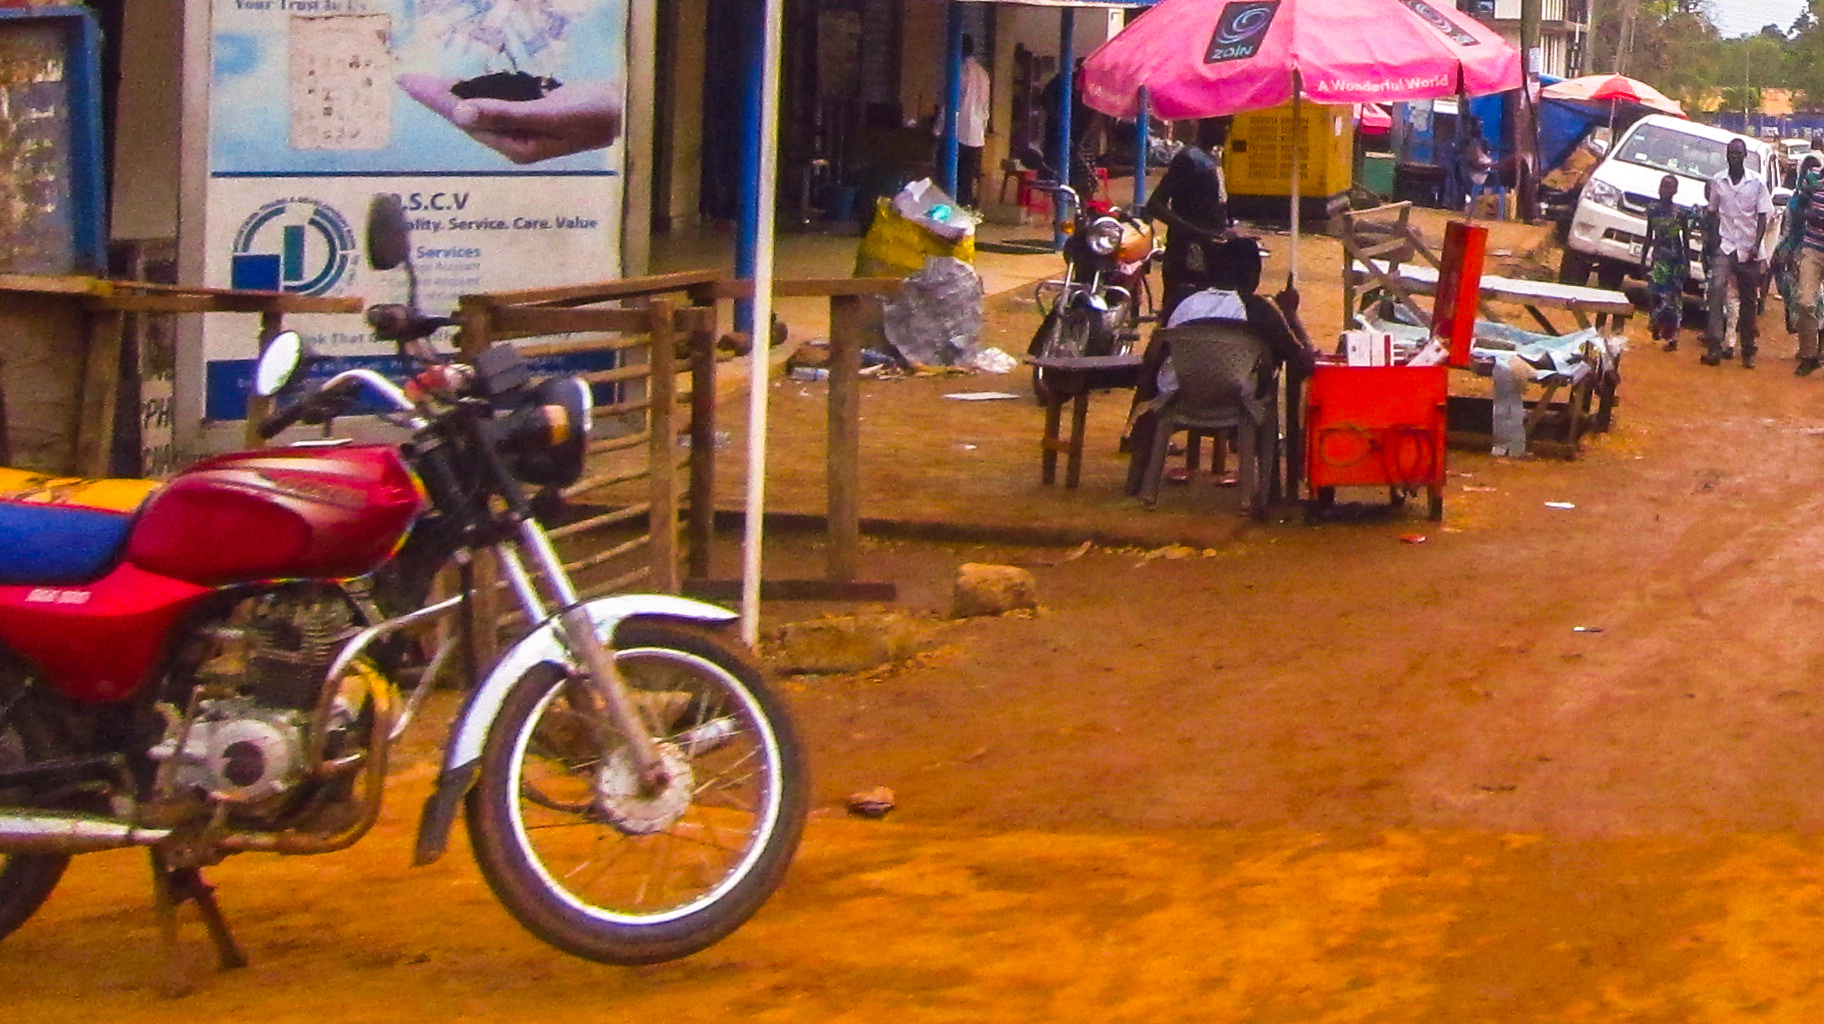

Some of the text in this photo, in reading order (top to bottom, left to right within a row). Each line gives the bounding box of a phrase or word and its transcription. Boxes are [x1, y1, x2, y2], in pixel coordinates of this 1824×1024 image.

[1317, 74, 1449, 93] A Wonderful World
[449, 216, 510, 231] Service.
[512, 216, 553, 230] Care.
[555, 215, 598, 229] Value
[416, 245, 482, 260] Services
